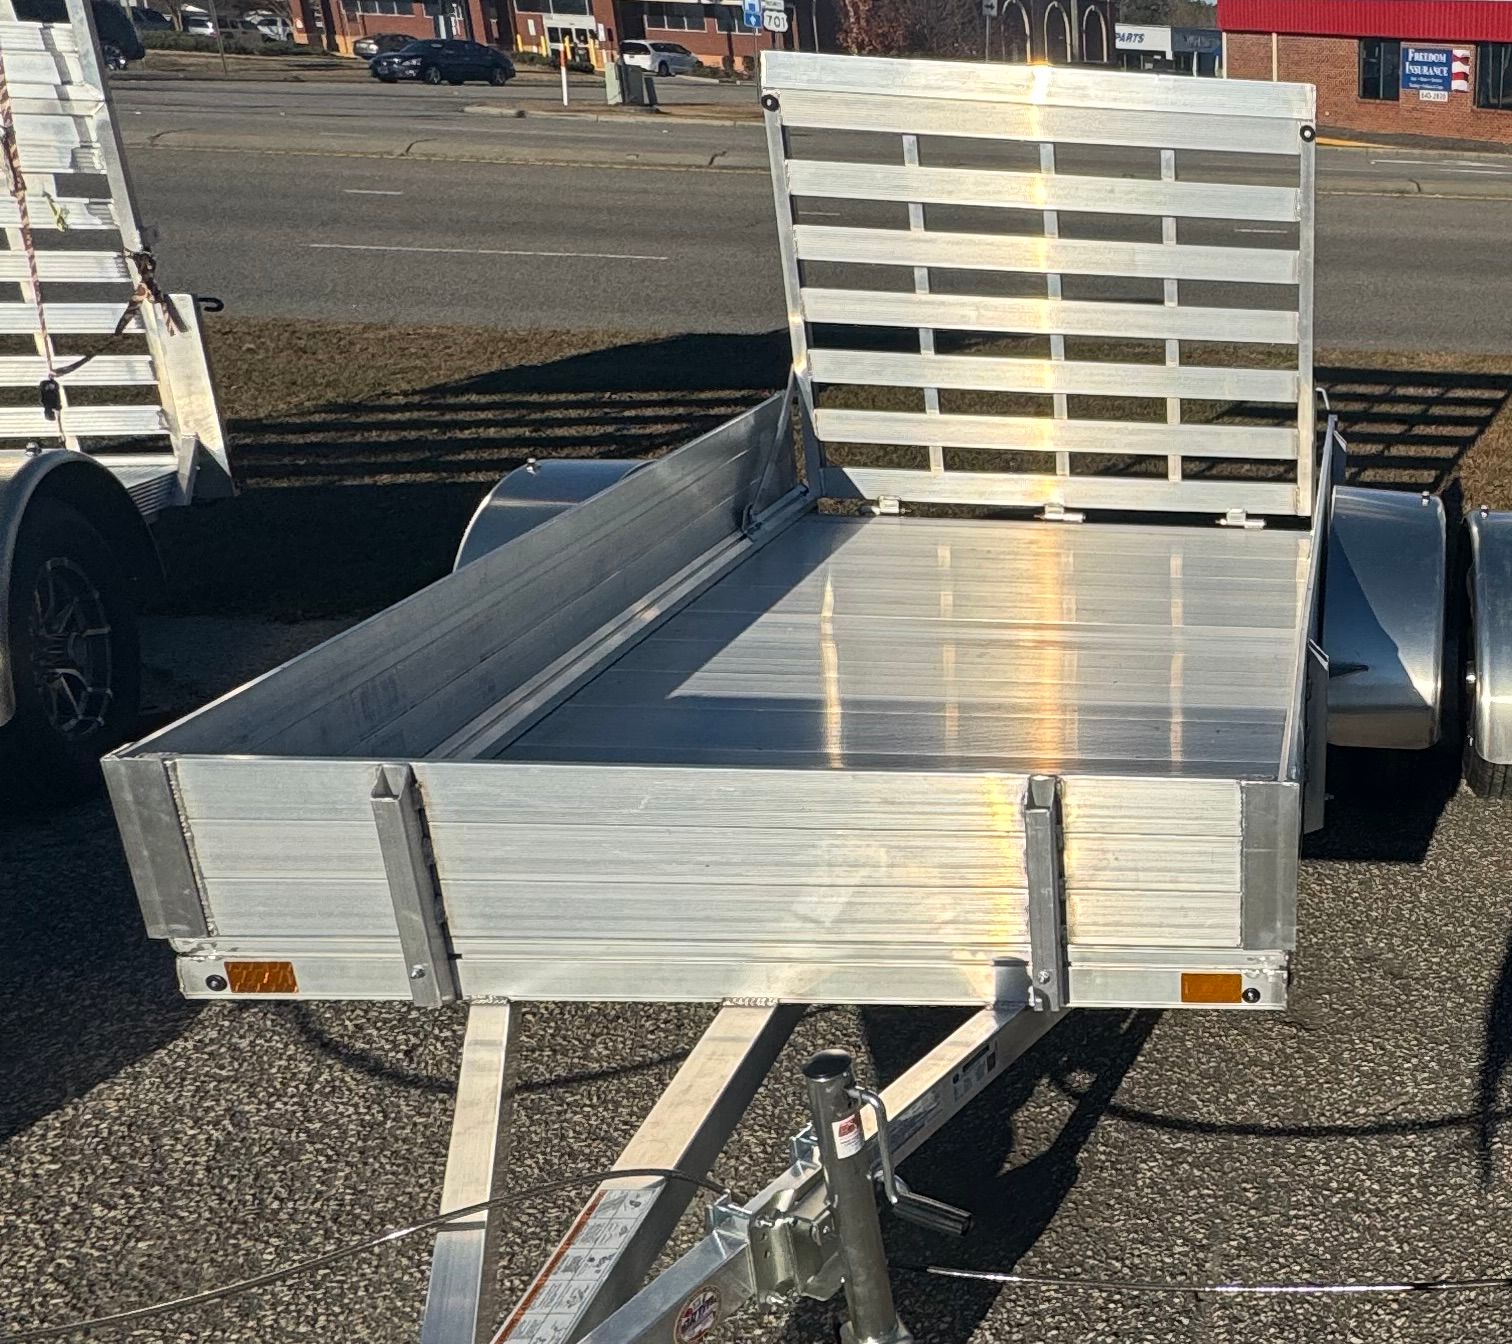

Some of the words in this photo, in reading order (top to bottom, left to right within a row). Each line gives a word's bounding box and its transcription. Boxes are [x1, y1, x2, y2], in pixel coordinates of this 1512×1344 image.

[766, 14, 786, 30] 701
[1408, 48, 1447, 63] FREEDOM
[1405, 61, 1449, 77] INSURANCE
